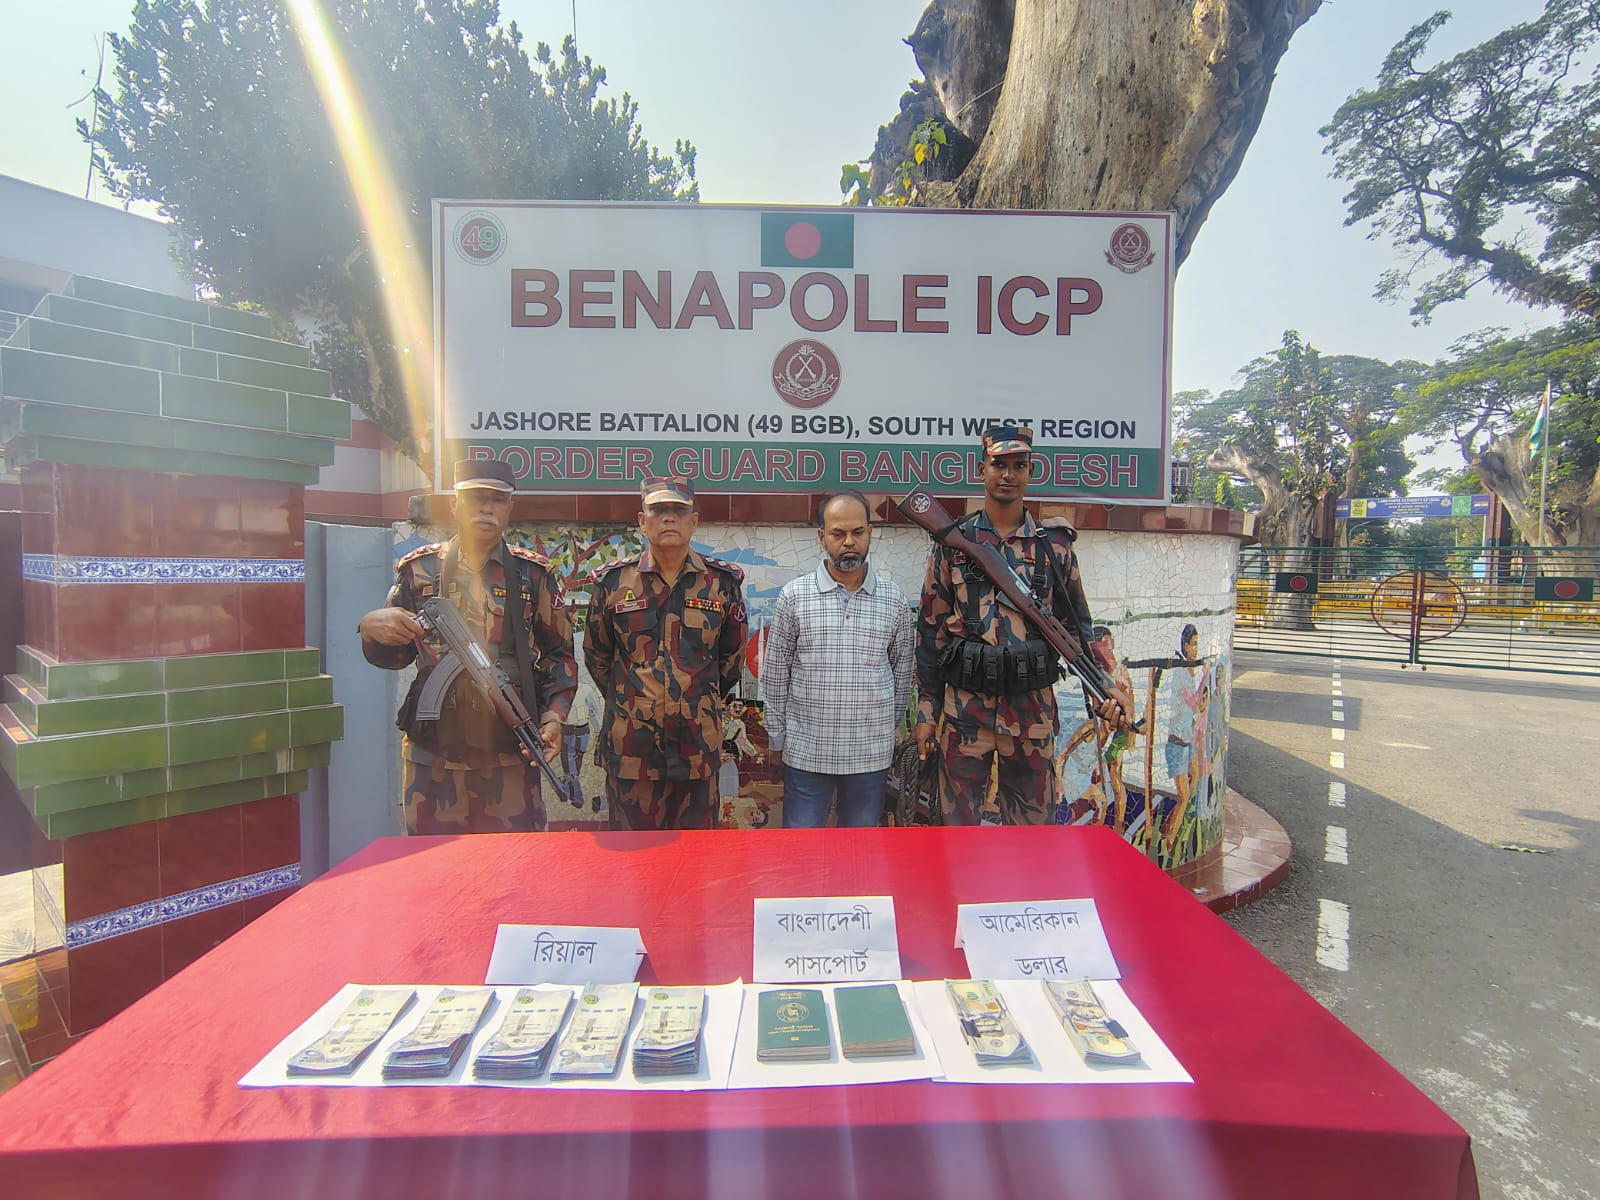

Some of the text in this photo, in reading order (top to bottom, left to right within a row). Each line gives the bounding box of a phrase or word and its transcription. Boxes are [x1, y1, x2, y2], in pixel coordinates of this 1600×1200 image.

[463, 225, 498, 251] 49
[510, 267, 1104, 336] BENAPOLE ICP
[470, 411, 592, 432] JASHORE
[599, 412, 740, 433] BATTALION
[747, 414, 783, 438] (49
[790, 415, 860, 438] BGB),
[867, 416, 954, 436] SOUTH
[1040, 419, 1137, 440] REGION
[667, 447, 826, 482] GUARD
[839, 450, 1139, 488] BANGLDESH
[776, 904, 873, 934] বাংলাদেশী
[978, 906, 1080, 934] আমেরিকান
[533, 931, 598, 965] রিয়াল
[784, 947, 870, 976] পাসপোর্ট
[1014, 955, 1069, 977] ডলার
